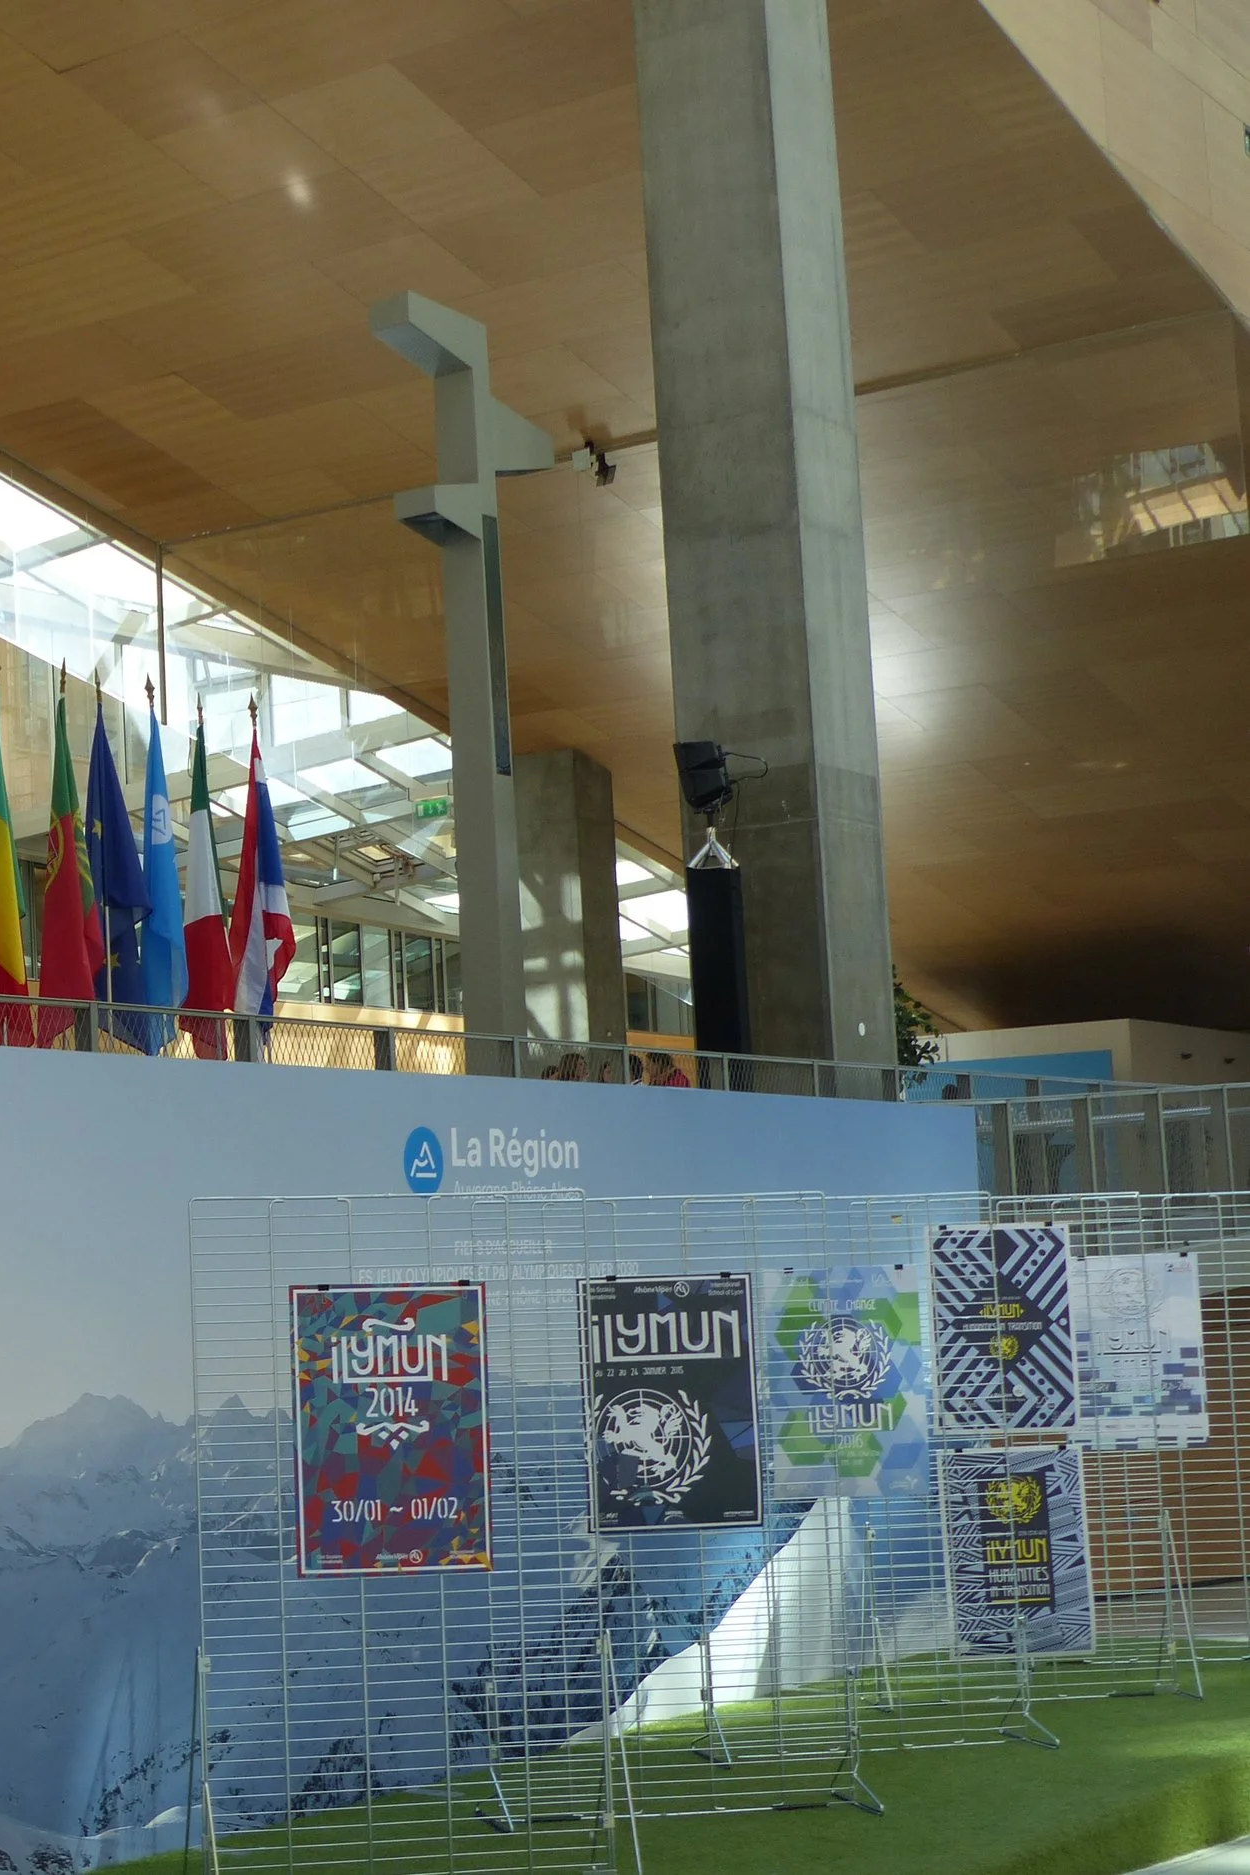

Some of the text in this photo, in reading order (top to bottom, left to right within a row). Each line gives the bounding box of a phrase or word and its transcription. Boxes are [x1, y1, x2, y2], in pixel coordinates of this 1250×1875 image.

[450, 1127, 580, 1177] La Région
[492, 1263, 574, 1281] PAALYMPQUES
[808, 1299, 838, 1312] CLIMTE
[365, 1386, 419, 1418] 2014
[838, 1434, 864, 1449] 2016
[331, 1499, 383, 1523] 30/01
[410, 1497, 459, 1521] 01/02
